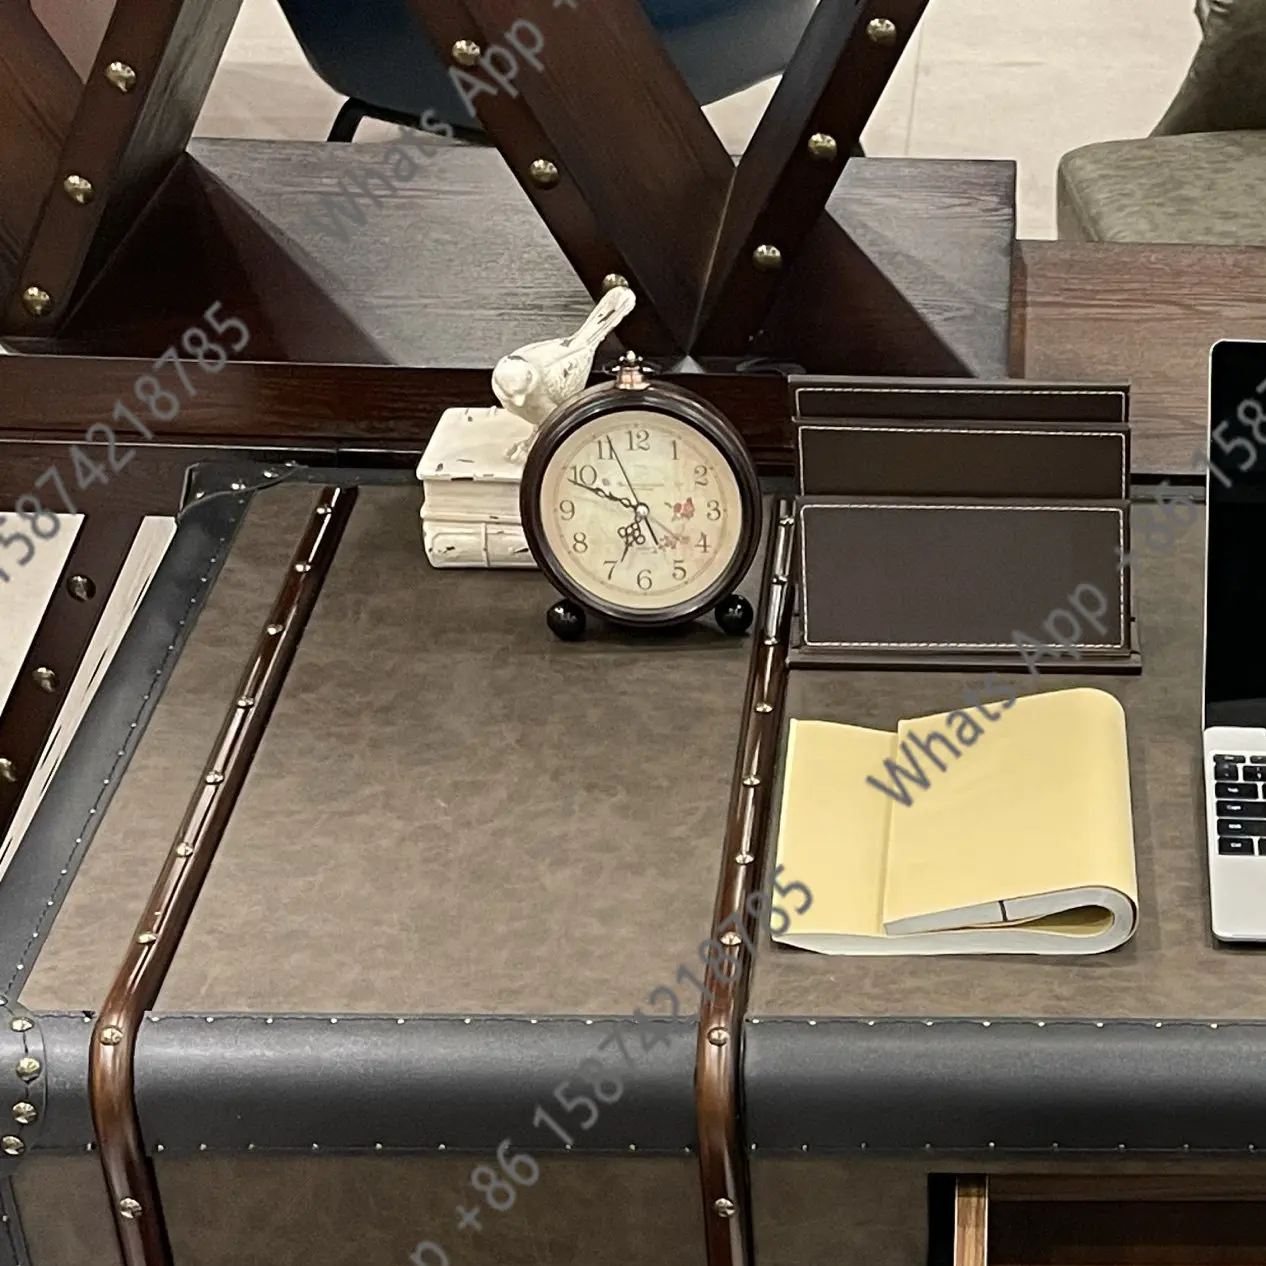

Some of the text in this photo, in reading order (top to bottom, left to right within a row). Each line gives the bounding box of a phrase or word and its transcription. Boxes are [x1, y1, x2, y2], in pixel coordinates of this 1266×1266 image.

[597, 439, 614, 460] 11
[627, 430, 650, 451] 12
[671, 440, 678, 460] 1
[571, 465, 597, 485] 10
[694, 465, 708, 486] 2
[559, 500, 575, 521] 9
[707, 500, 721, 520] 3
[573, 532, 588, 553] 8
[694, 532, 712, 553] 4
[603, 560, 618, 581] 7
[636, 569, 652, 590] 6
[672, 560, 687, 580] 5
